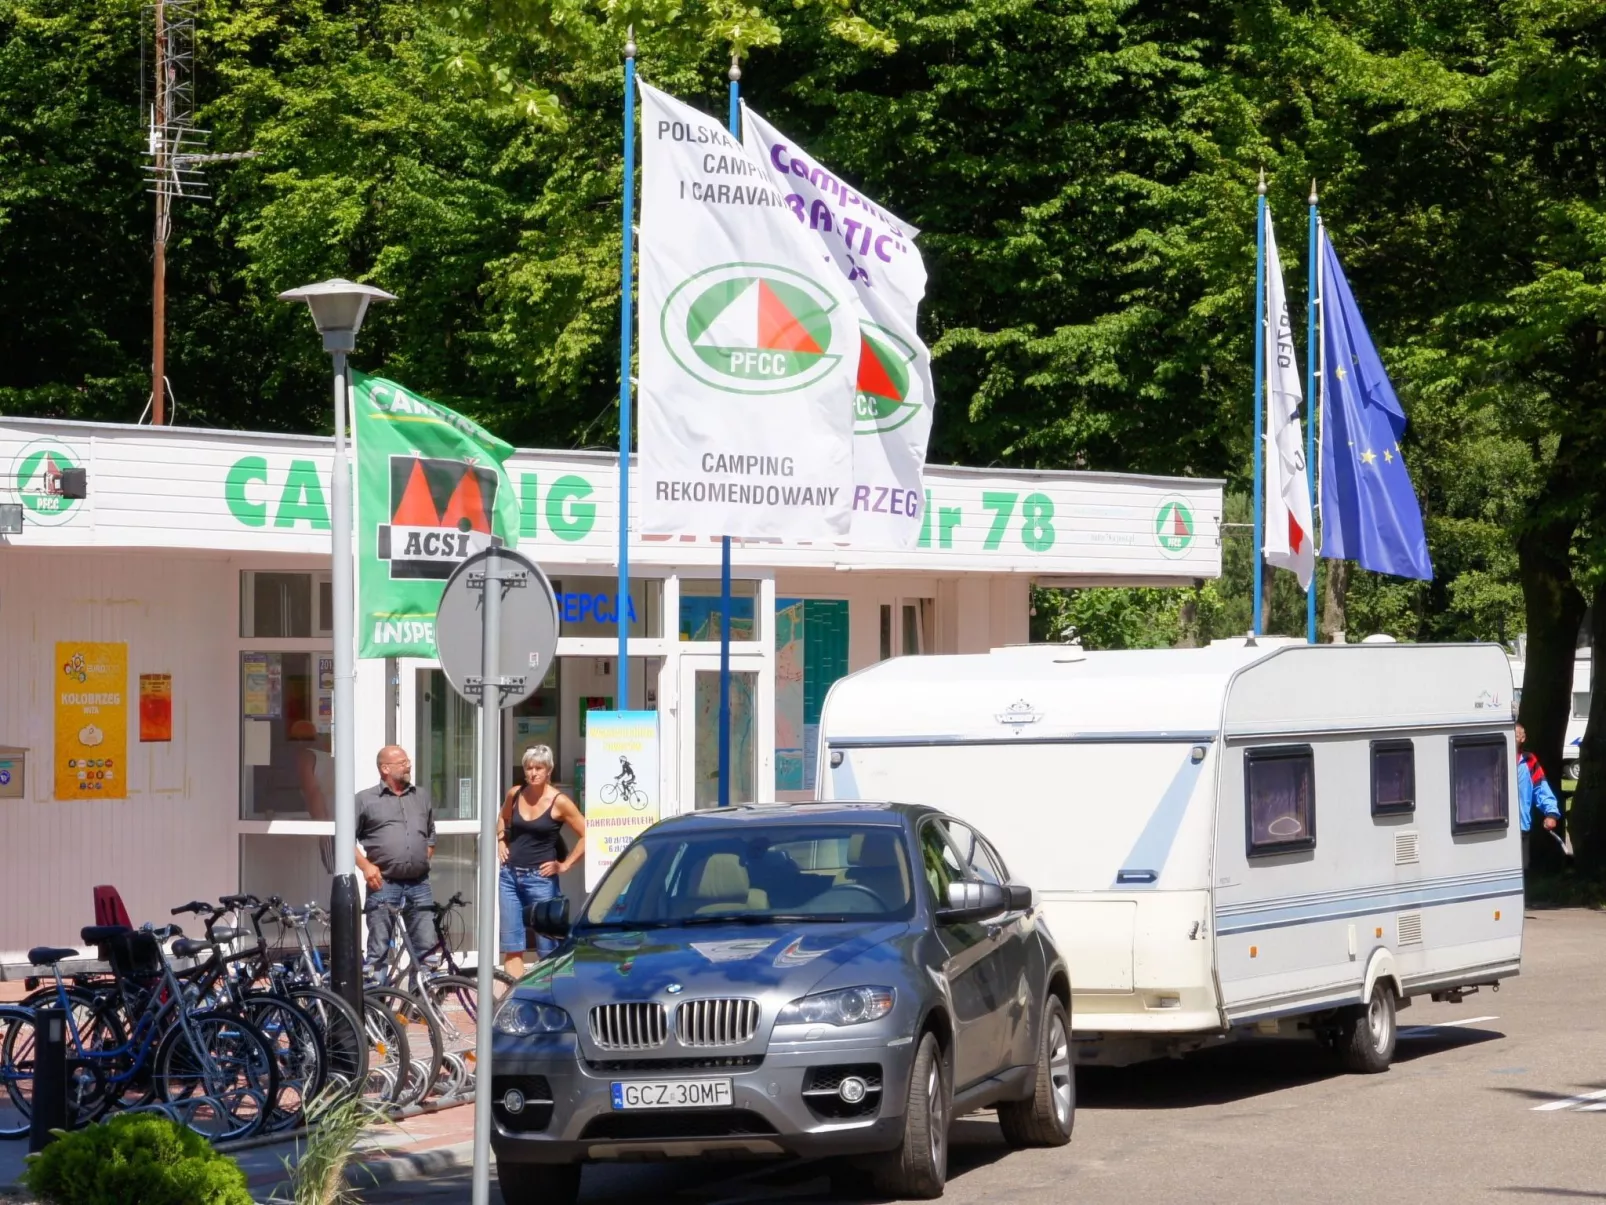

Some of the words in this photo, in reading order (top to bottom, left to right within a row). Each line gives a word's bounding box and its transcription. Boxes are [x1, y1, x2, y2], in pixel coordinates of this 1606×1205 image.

[658, 121, 733, 149] POLSKA
[692, 182, 788, 208] CARAVAN
[730, 352, 786, 376] PFCC
[702, 453, 794, 476] CAMPING
[656, 481, 840, 506] REKOMENDOWANY
[982, 492, 1055, 552] 78
[404, 532, 470, 557] ACSI
[373, 622, 435, 643] INSPE
[586, 816, 654, 828] FAHRRADVERLEIH
[626, 1085, 669, 1105] GCZ
[676, 1083, 726, 1103] 30MF
